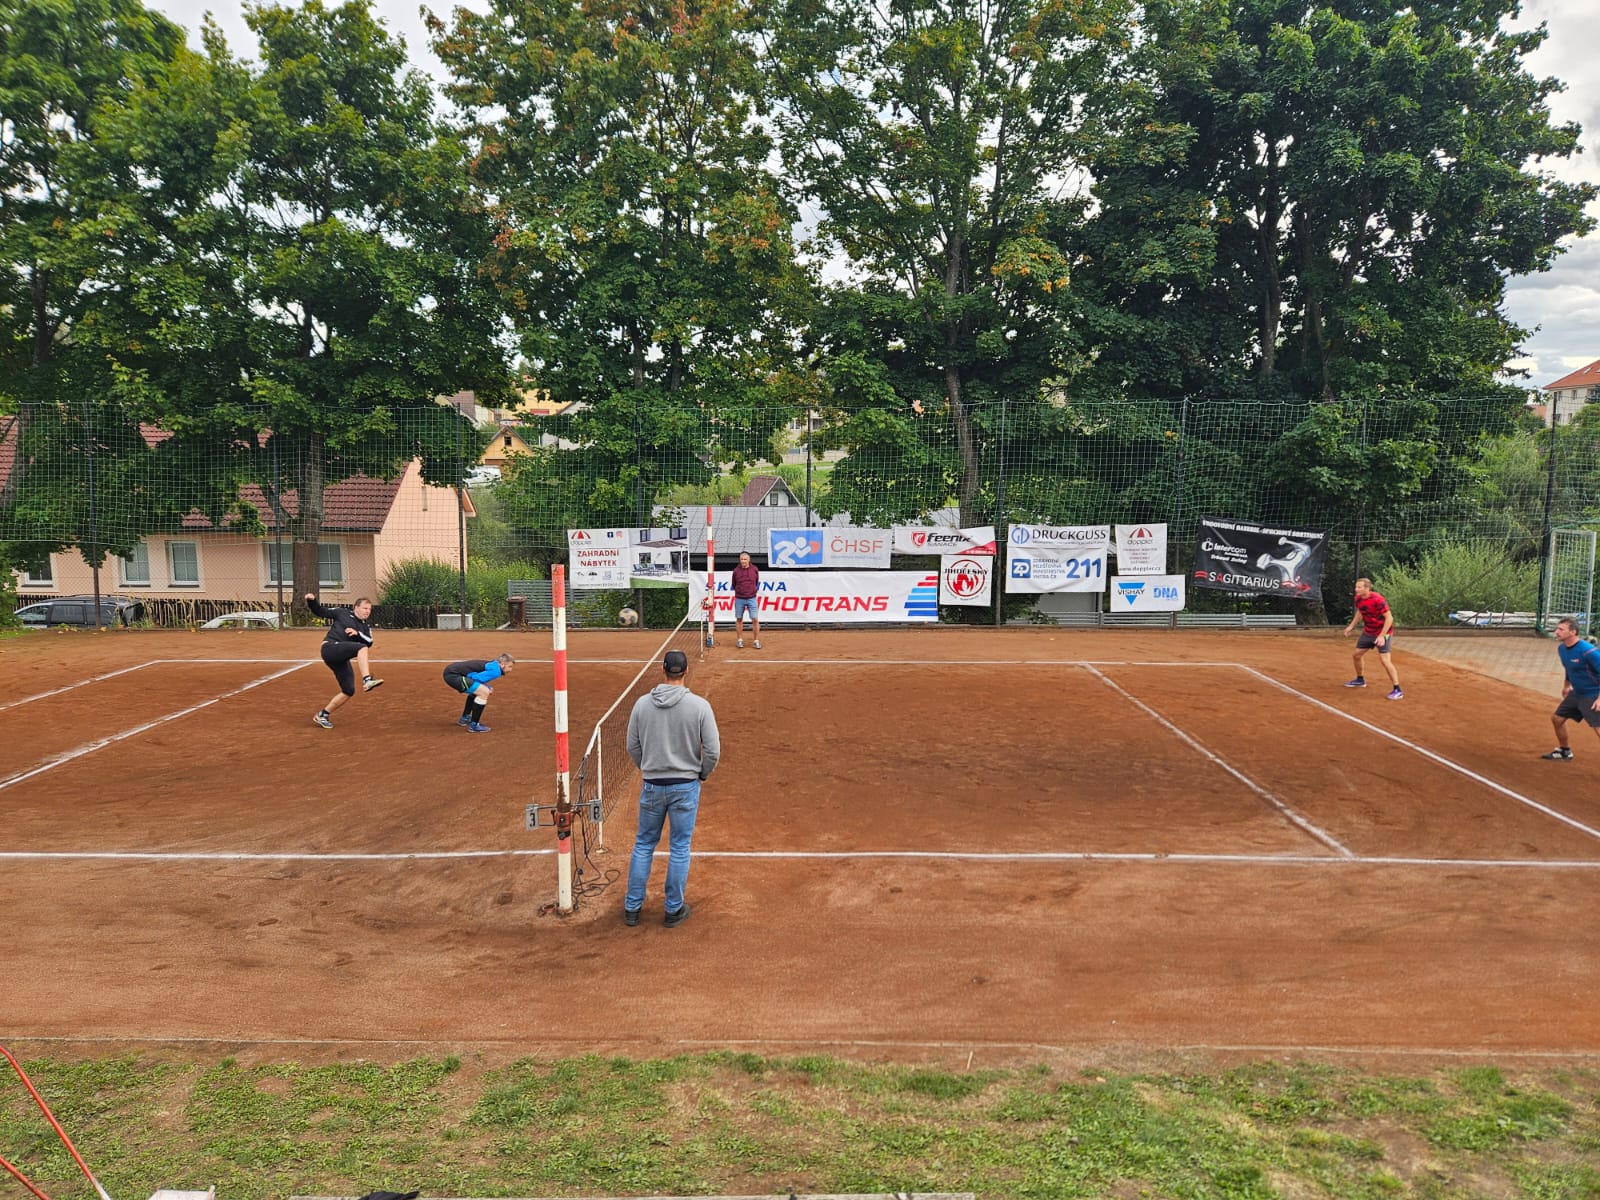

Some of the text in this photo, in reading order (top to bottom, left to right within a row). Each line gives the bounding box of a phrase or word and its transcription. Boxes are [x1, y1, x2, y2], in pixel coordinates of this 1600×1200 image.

[1032, 528, 1106, 541] DRUCKGUSS
[830, 536, 884, 553] ČHSF
[1214, 543, 1247, 554] Intercom
[577, 549, 619, 558] ZAHRADNÍ
[580, 558, 617, 567] NÁBYTEK
[1066, 558, 1101, 578] 211
[1208, 571, 1280, 589] SAGITTARIUS
[1117, 588, 1145, 596] VISHAY
[744, 596, 889, 611] IHOTRANS
[529, 812, 536, 827] 3
